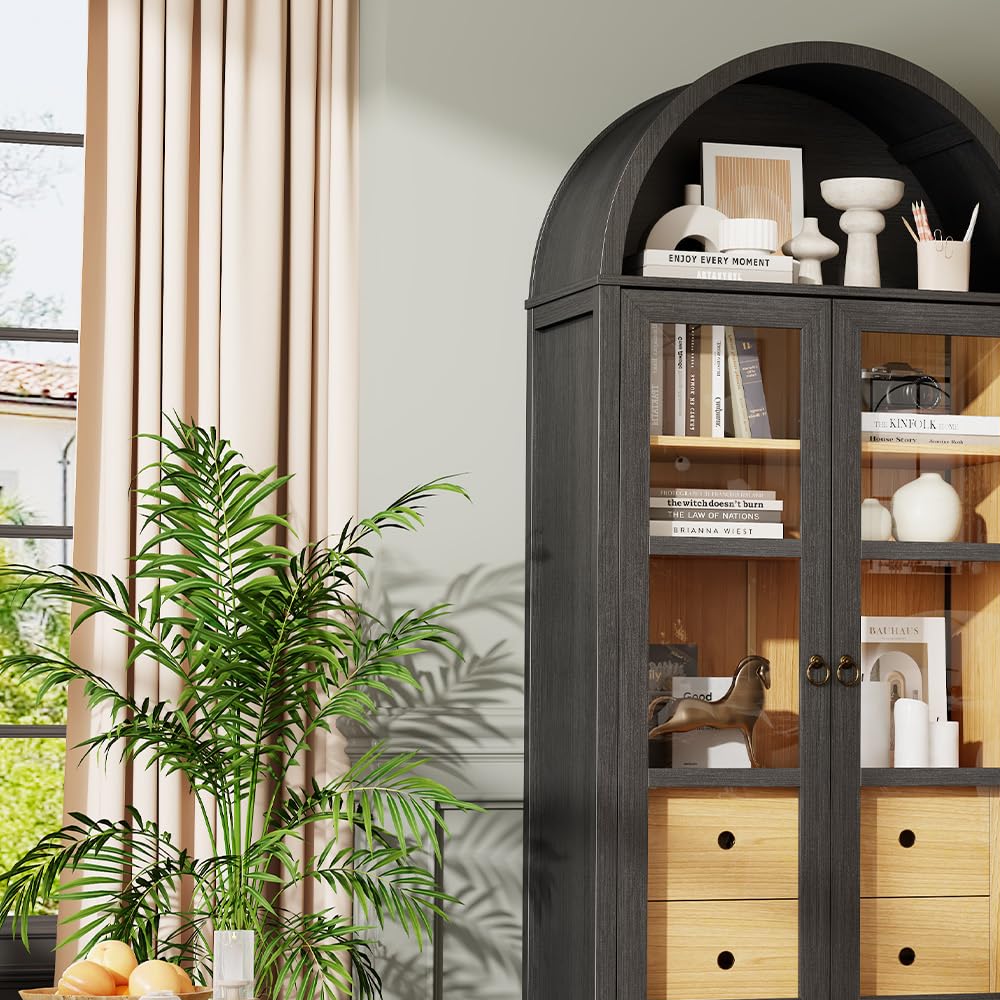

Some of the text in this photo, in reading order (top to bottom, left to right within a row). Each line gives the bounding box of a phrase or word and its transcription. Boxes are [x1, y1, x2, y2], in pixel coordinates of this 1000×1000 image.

[668, 254, 770, 267] ENJOY EVERY MOMENT
[889, 418, 937, 429] KINFOLK
[895, 436, 917, 444] Story
[743, 500, 764, 508] burn
[687, 511, 706, 519] LAW
[722, 512, 760, 521] NATIONS
[673, 526, 719, 535] BRIANNA
[869, 626, 919, 635] BAUHAUS
[683, 692, 713, 701] Good
